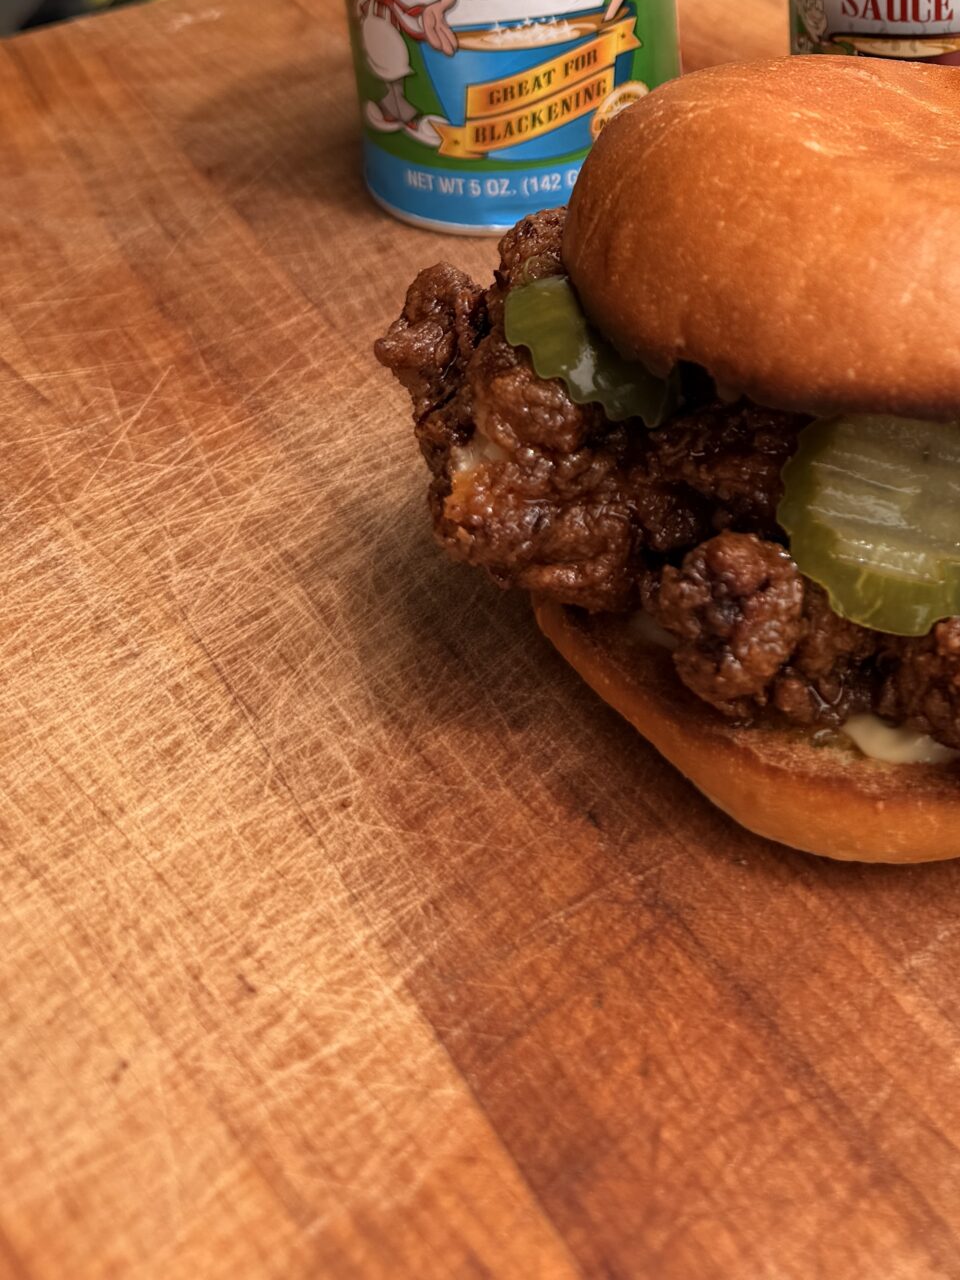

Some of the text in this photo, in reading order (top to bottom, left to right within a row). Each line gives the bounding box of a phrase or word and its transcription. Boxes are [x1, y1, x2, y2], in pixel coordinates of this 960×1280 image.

[489, 49, 598, 106] GREAT FOR
[474, 78, 607, 144] BLACKENING
[406, 170, 434, 188] NET
[439, 176, 465, 194] WT
[469, 179, 481, 197] 5
[522, 172, 561, 197] (142
